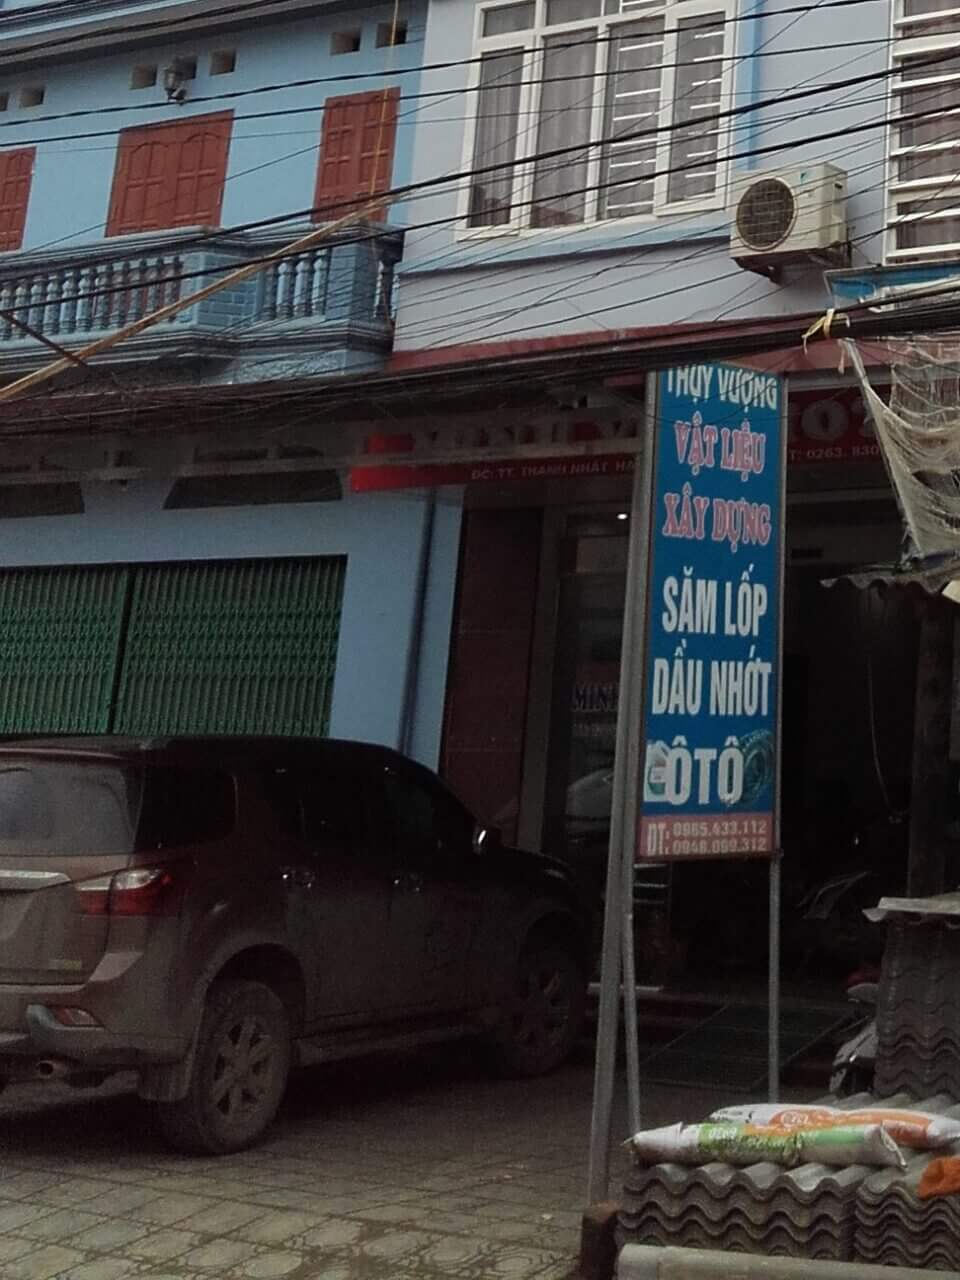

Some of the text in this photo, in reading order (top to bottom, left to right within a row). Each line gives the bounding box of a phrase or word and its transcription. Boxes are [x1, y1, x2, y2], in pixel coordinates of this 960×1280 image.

[674, 410, 718, 476] VẬT
[720, 418, 766, 482] LIỆU
[662, 481, 772, 553] XÂY DỰNG
[662, 563, 768, 637] SĂM LỐP
[652, 638, 772, 716] DẦU NHỚT
[667, 735, 744, 806] ÔTÔ
